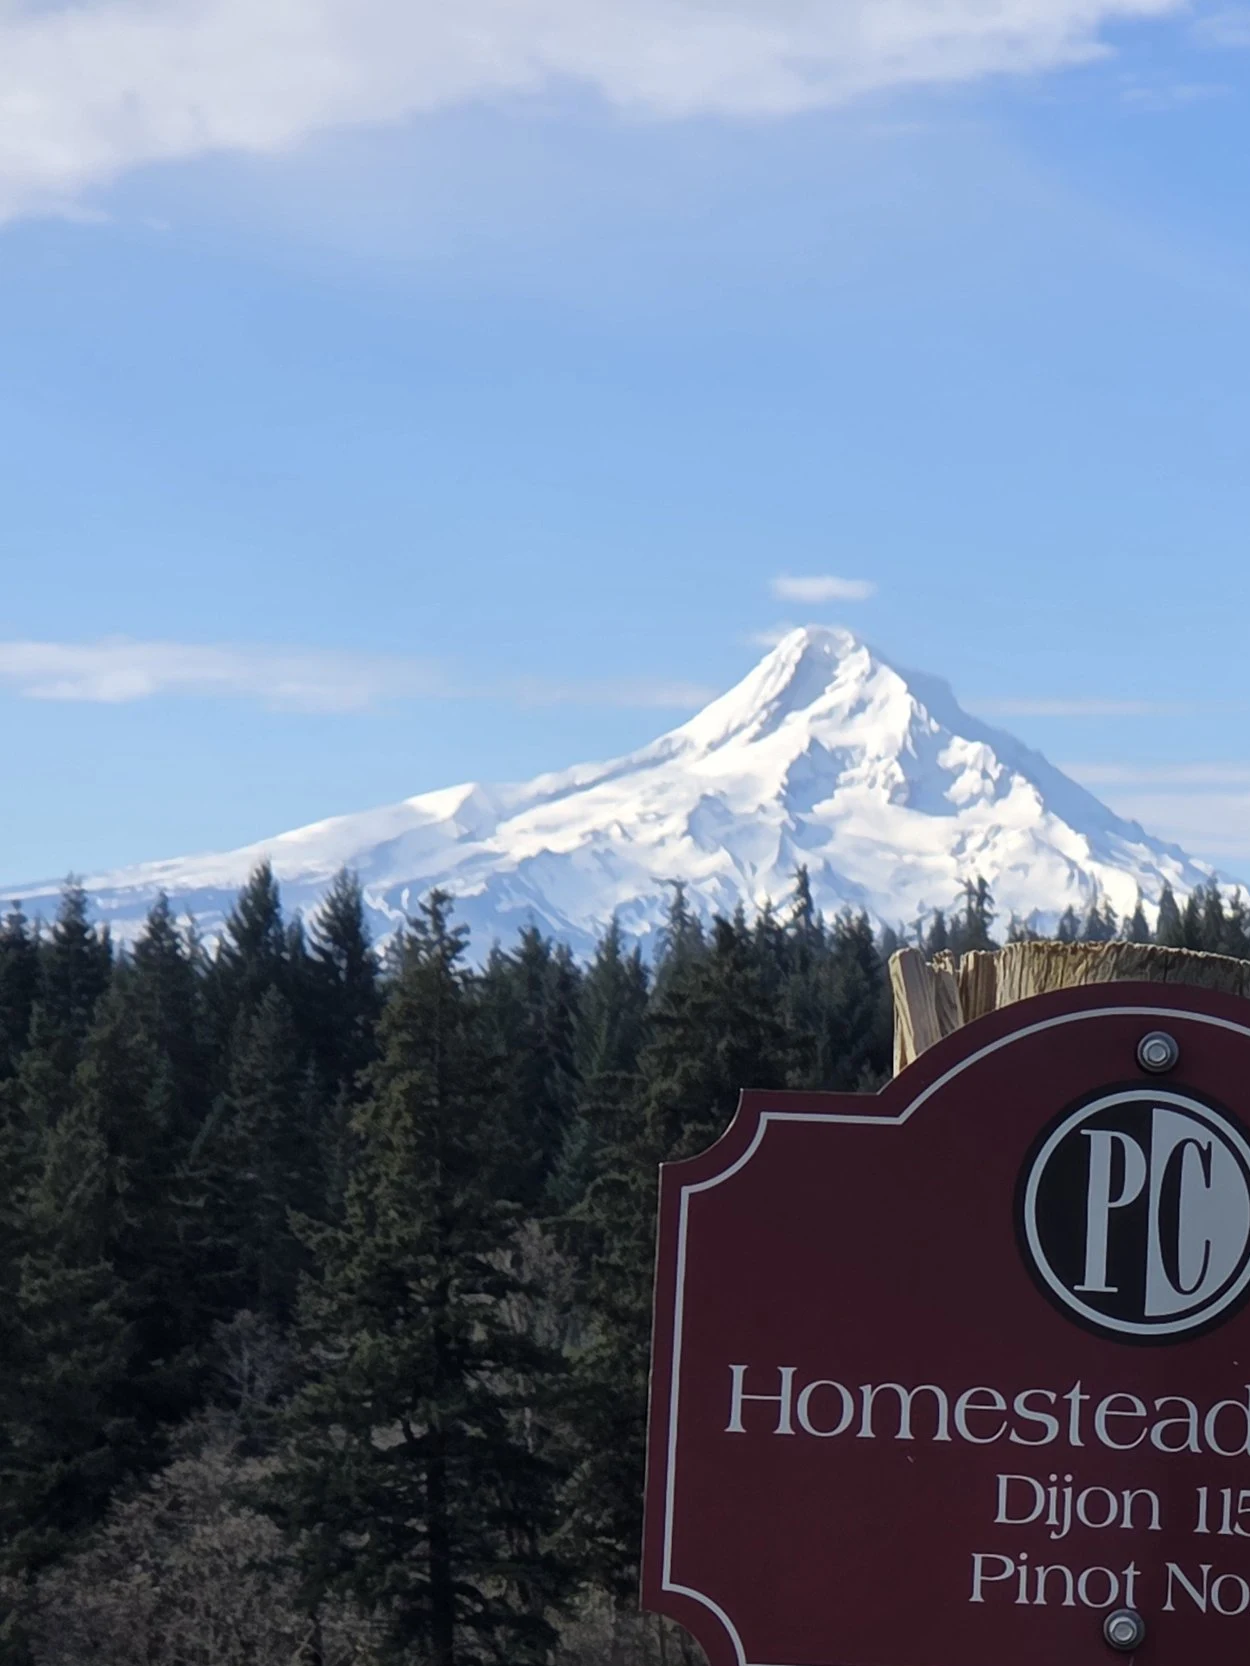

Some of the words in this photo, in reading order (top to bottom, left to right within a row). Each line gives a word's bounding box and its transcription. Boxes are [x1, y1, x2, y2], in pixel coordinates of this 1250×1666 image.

[1072, 1128, 1214, 1294] PC
[994, 1472, 1160, 1539] Dijon
[969, 1551, 1141, 1610] Pinot
